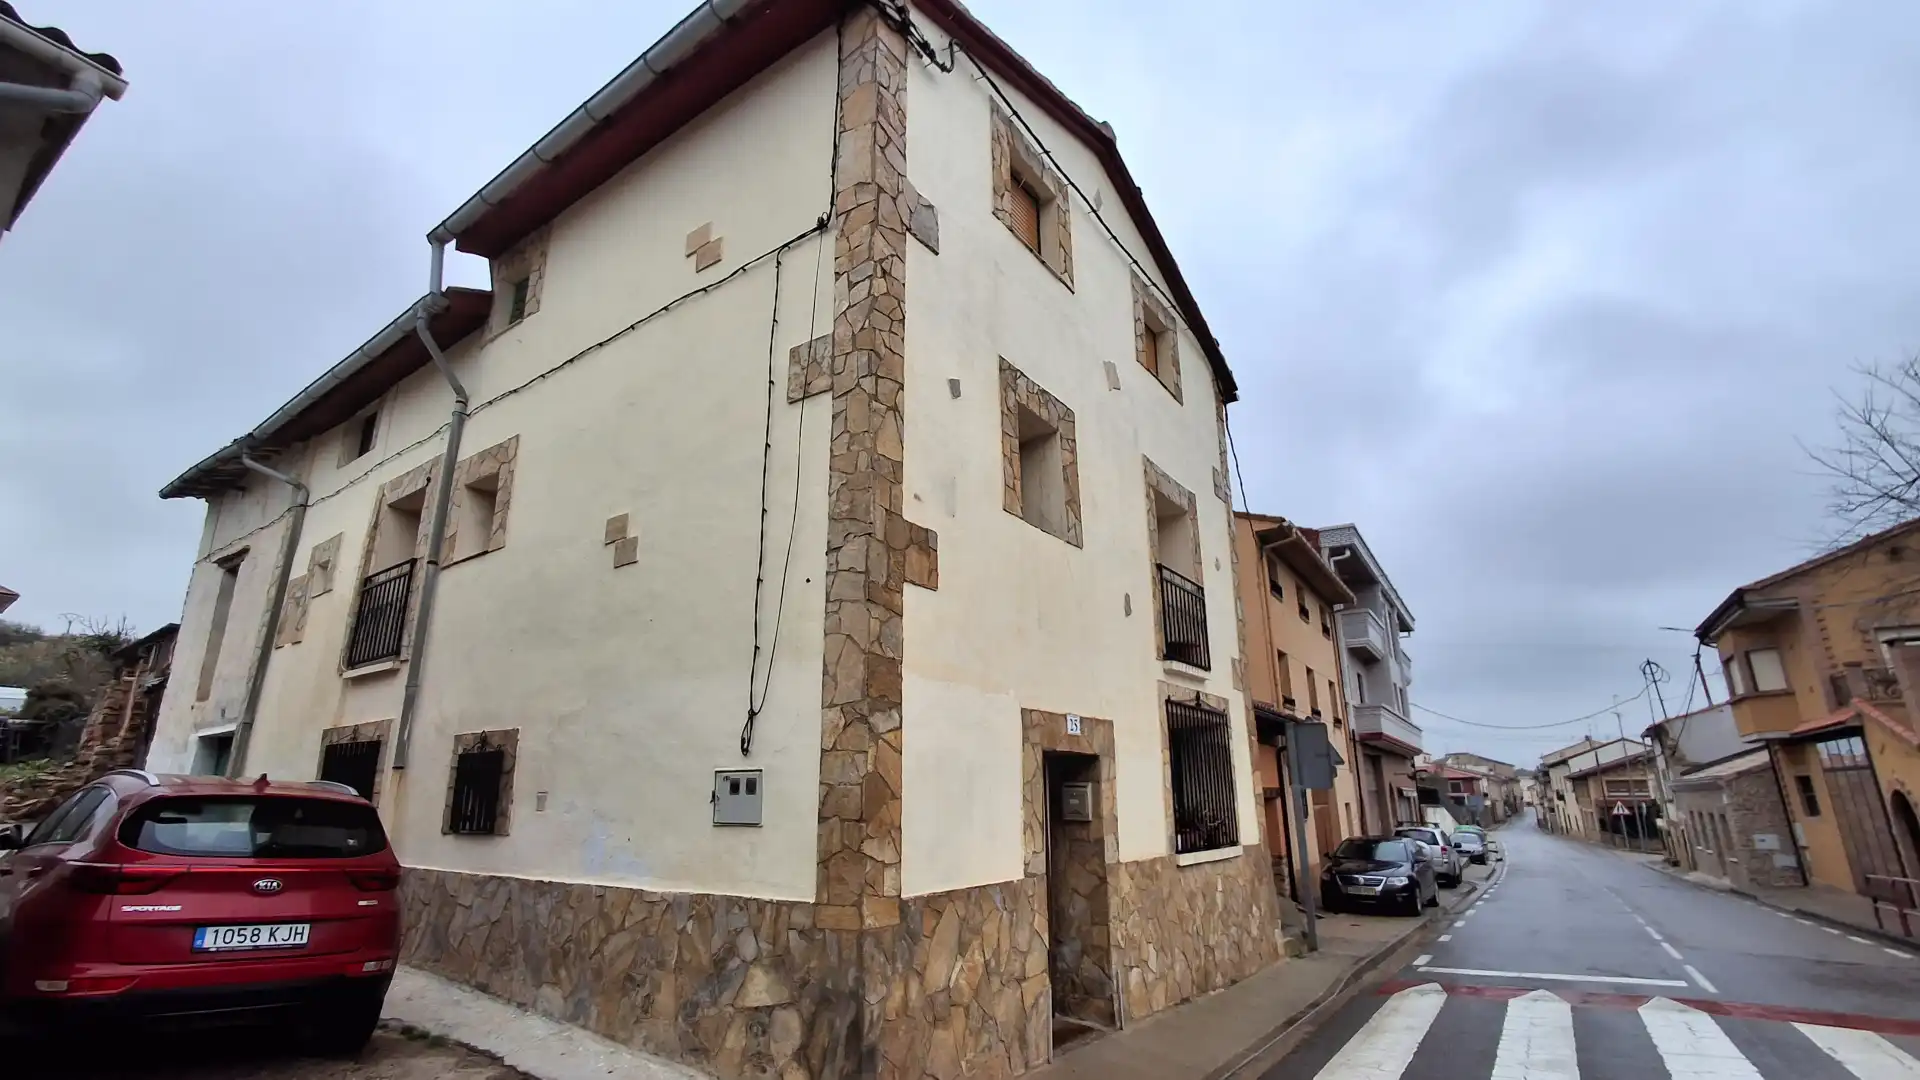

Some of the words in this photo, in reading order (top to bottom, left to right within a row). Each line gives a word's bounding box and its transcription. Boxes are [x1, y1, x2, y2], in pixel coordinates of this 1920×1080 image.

[258, 880, 279, 890] KIA
[213, 928, 261, 945] 1058
[267, 926, 305, 942] KJH
